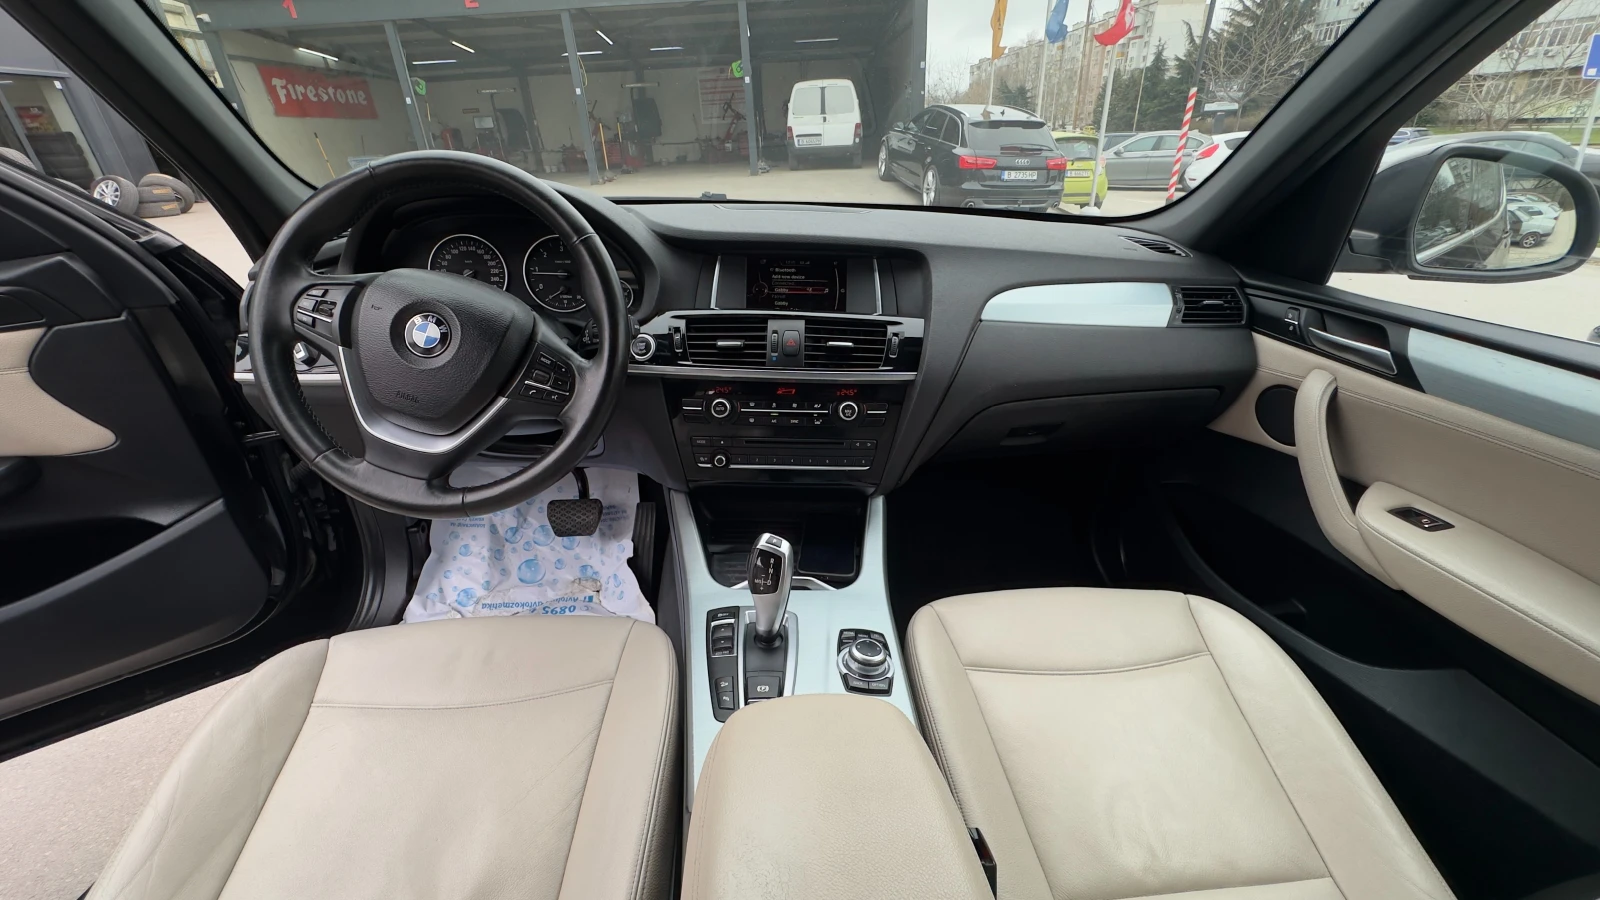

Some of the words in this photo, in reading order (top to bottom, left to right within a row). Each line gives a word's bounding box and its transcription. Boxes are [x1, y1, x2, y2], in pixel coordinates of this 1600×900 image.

[282, 0, 298, 19] 1
[271, 77, 368, 106] Firestone
[413, 315, 448, 333] BMW
[542, 605, 577, 615] 0895
